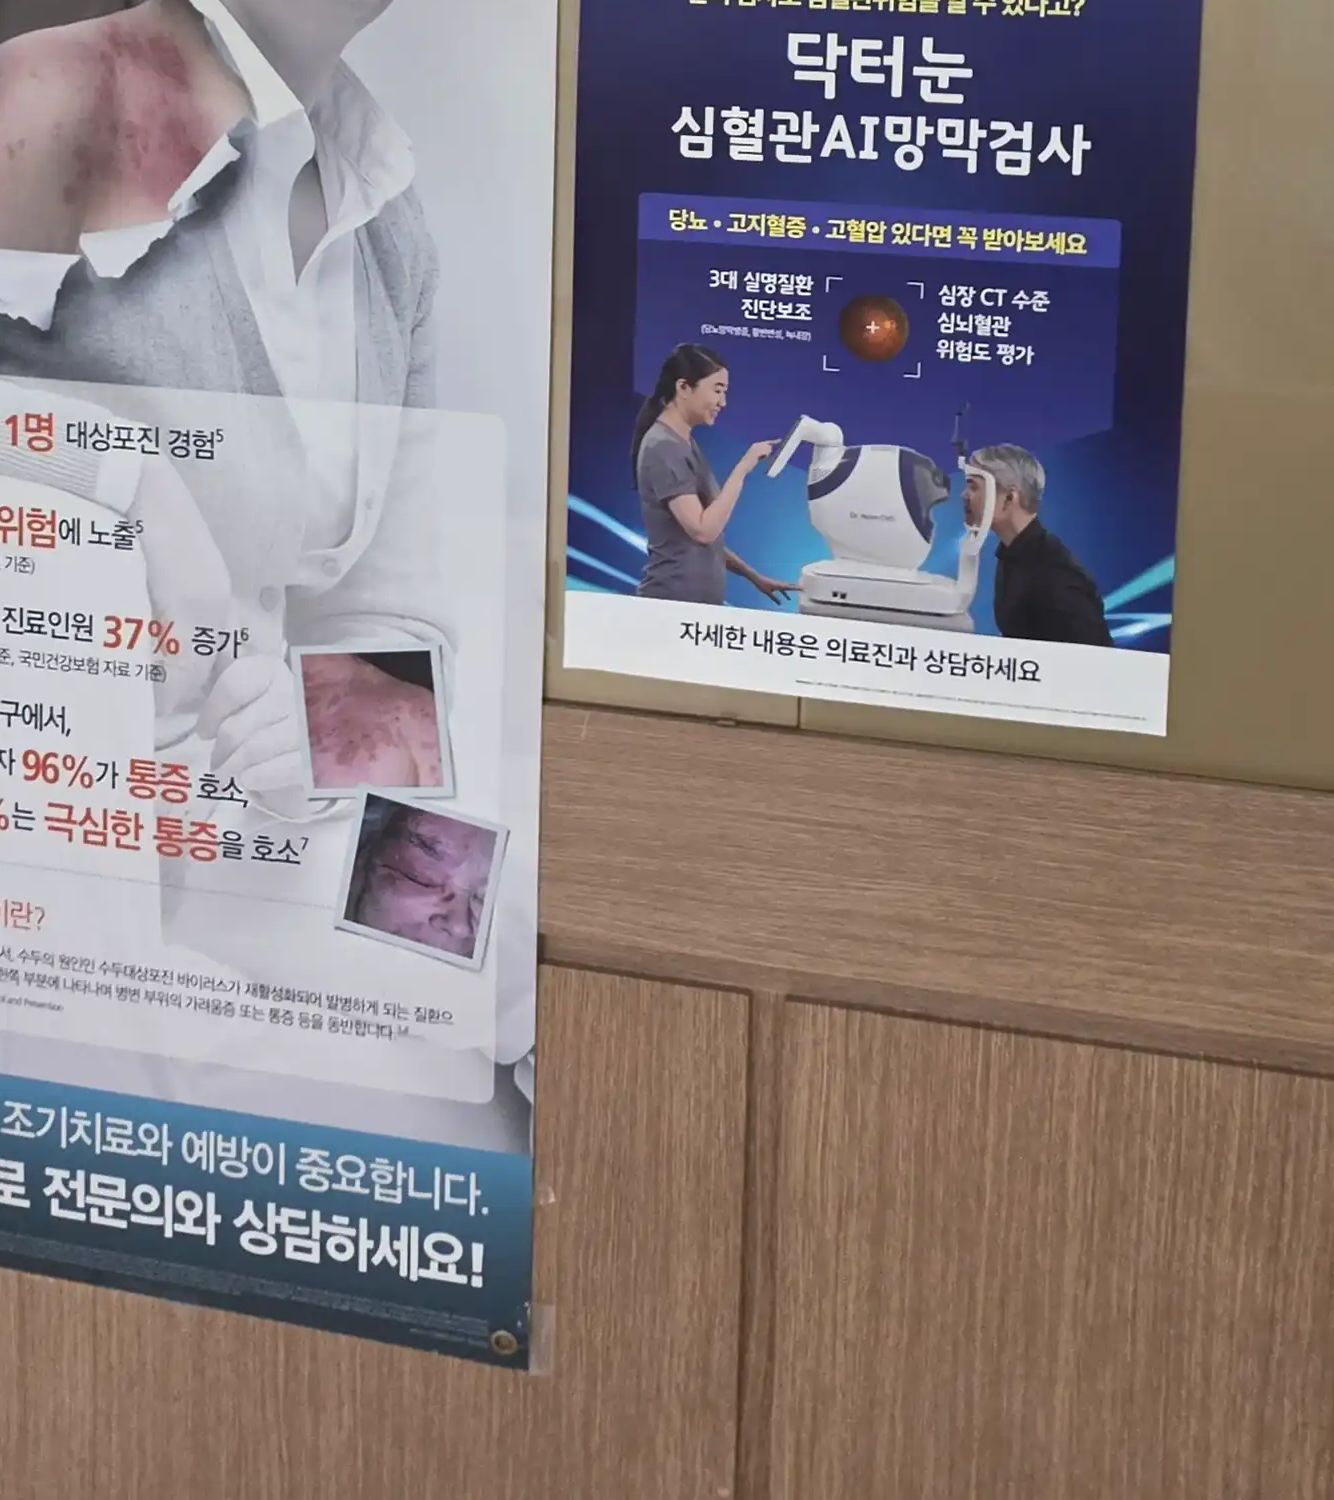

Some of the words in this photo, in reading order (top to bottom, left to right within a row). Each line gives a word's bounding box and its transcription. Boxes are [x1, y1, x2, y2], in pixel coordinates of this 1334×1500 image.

[787, 32, 973, 104] 닥터눈
[671, 105, 1091, 176] 심혈관AI망막검사
[669, 208, 708, 231] 당뇨
[727, 212, 807, 238] 고지혈증
[826, 217, 886, 244] 고혈압
[892, 222, 952, 246] 있다면
[957, 226, 978, 250] 꼭
[983, 227, 1087, 255] 받아보세요
[709, 269, 737, 290] 3대
[743, 270, 814, 296] 실명질환
[938, 285, 976, 308] 심장
[980, 288, 1007, 307] CT
[1011, 288, 1050, 312] 수준
[741, 299, 813, 321] 진단보조
[937, 312, 1011, 336] 심뇌혈관
[936, 338, 991, 362] 위험도
[996, 342, 1034, 366] 평가
[5, 413, 54, 452] 1명
[66, 420, 160, 455] 대상포진
[3, 606, 94, 643] 진료인원
[103, 615, 180, 656] 37%
[679, 621, 747, 650] 자세한
[752, 627, 820, 658] 내용은
[826, 638, 917, 671] 의료진과
[924, 649, 1041, 683] 상담하세요
[22, 749, 119, 790] 96%가
[126, 759, 191, 803] 통증
[1, 1101, 172, 1165] 조기치료와
[182, 1130, 286, 1186] 예방이
[296, 1146, 490, 1217] 중요합니다.
[43, 1167, 220, 1245] 전문의와
[234, 1200, 485, 1287] 상담하세요!
